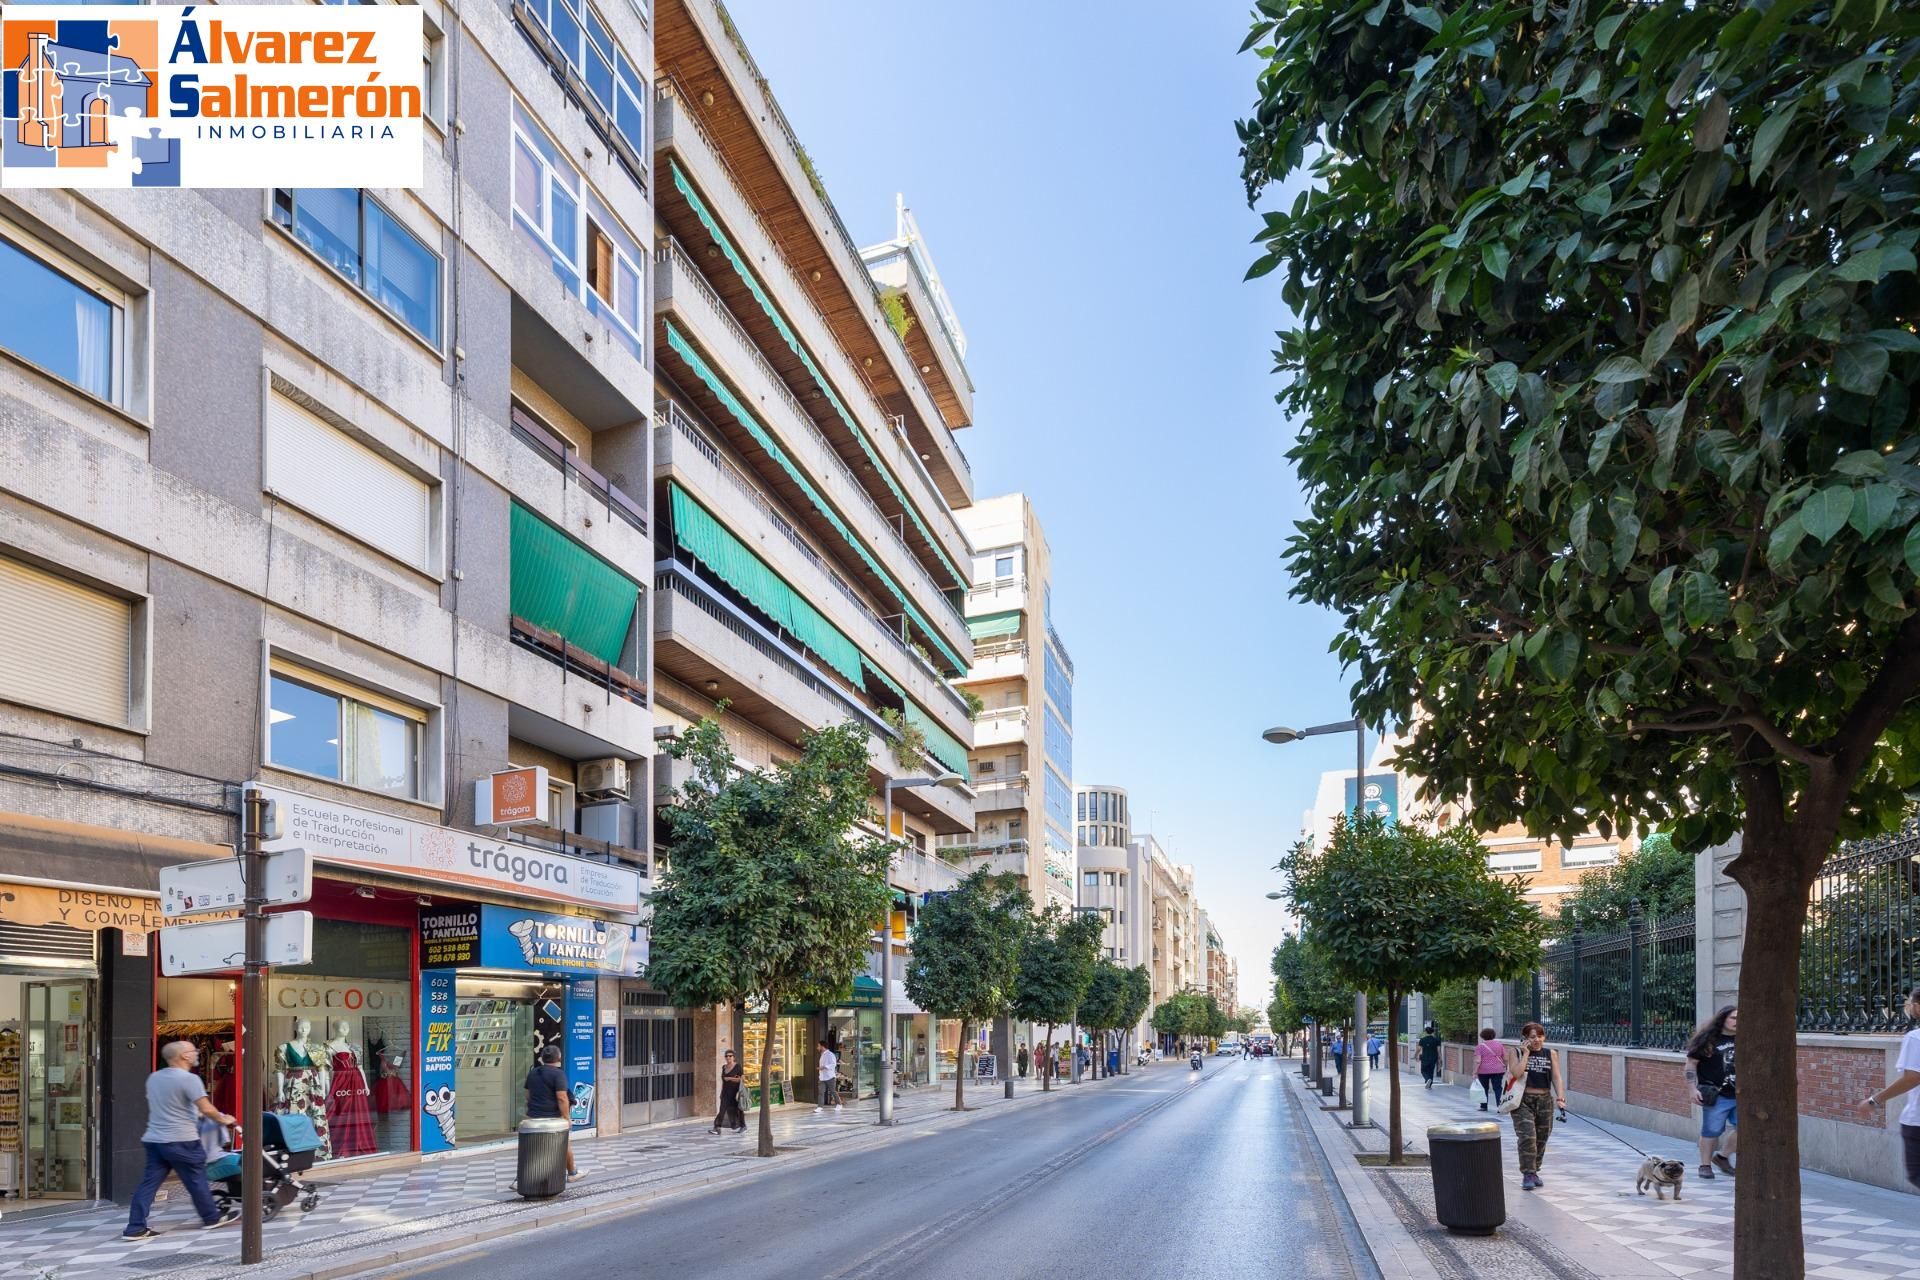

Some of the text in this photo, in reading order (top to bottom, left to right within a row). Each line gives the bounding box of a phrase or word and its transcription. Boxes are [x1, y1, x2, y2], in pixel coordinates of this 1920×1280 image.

[500, 805, 531, 816] trágora
[293, 804, 404, 836] Escuela Profesional
[292, 817, 375, 841] de Traducción
[292, 830, 388, 855] e Interpretación
[467, 841, 568, 883] trágora
[580, 866, 608, 879] Empresa
[580, 876, 622, 891] de Traducción
[585, 886, 614, 898] Locución
[58, 908, 71, 921] Y
[422, 913, 478, 929] TORNILLO
[422, 926, 478, 939] Y PANTALLA
[534, 921, 607, 945] TORNILLO
[535, 942, 607, 960] Y PANTALLA
[534, 957, 561, 966] MOBILE
[563, 959, 584, 968] PHONE
[431, 979, 448, 987] 602
[431, 992, 448, 1000] 538
[431, 1005, 448, 1013] 863
[426, 1033, 452, 1052] FIX
[426, 1055, 452, 1063] SERVICIO
[335, 1088, 369, 1097] cocon
